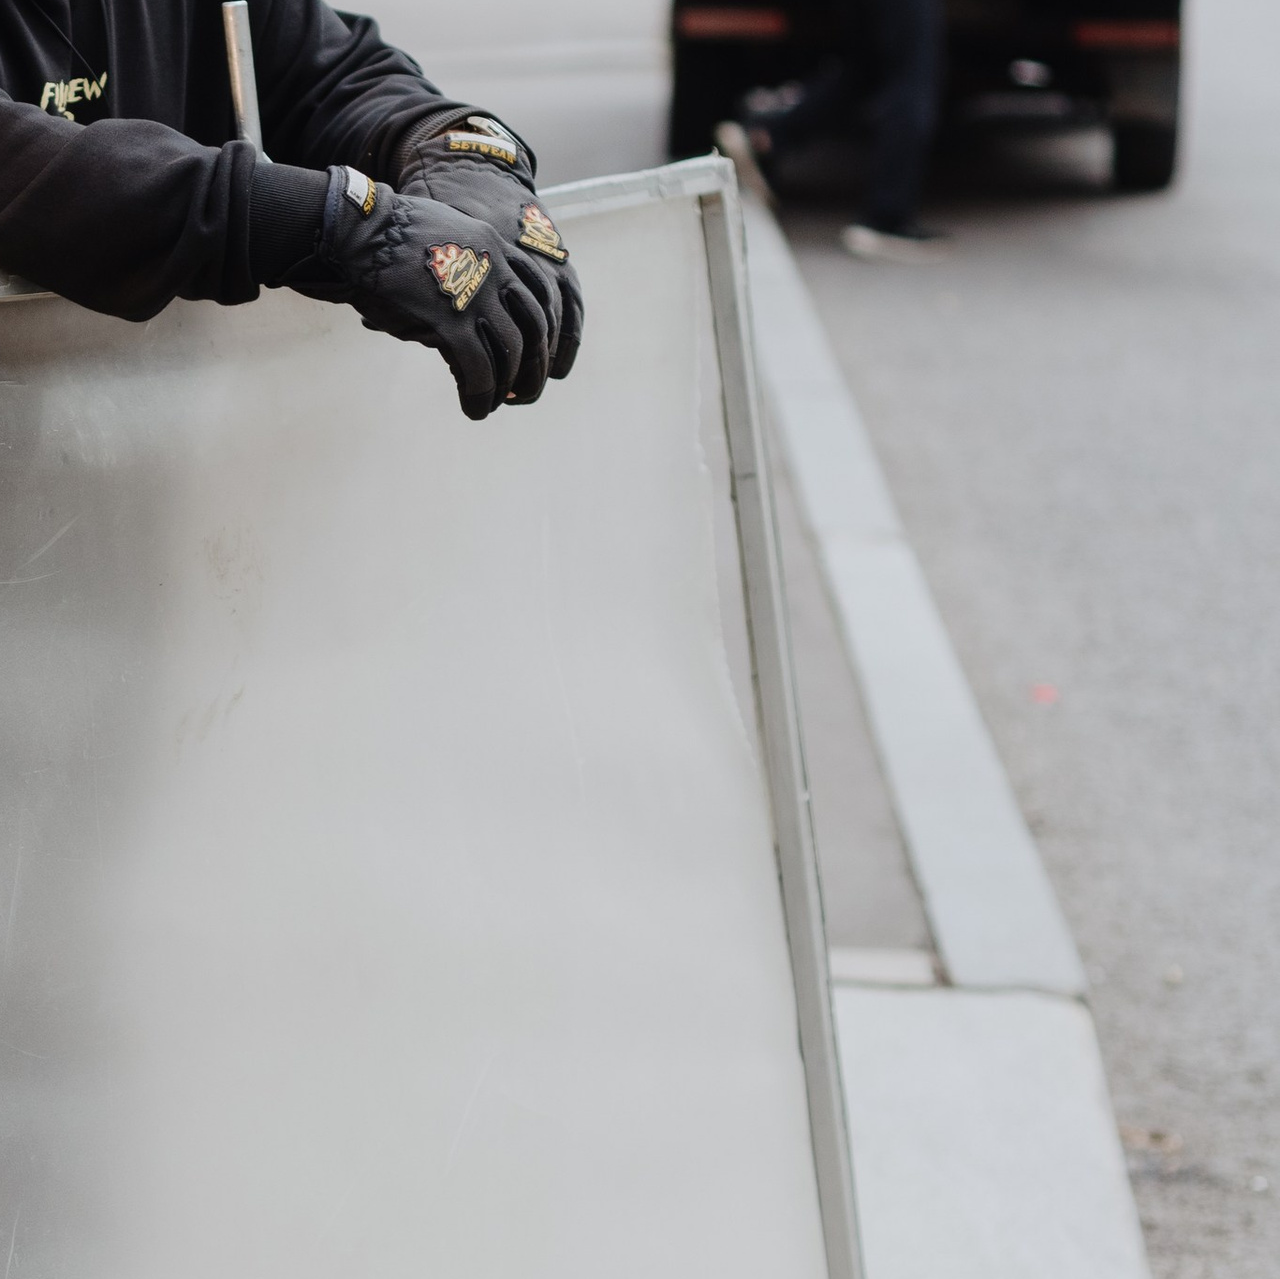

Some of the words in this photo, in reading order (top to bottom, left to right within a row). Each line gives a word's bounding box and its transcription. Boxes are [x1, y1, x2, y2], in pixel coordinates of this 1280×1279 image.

[449, 140, 517, 164] SETWEAR
[520, 234, 565, 259] SETWEAR
[456, 258, 490, 310] SETWEAR
